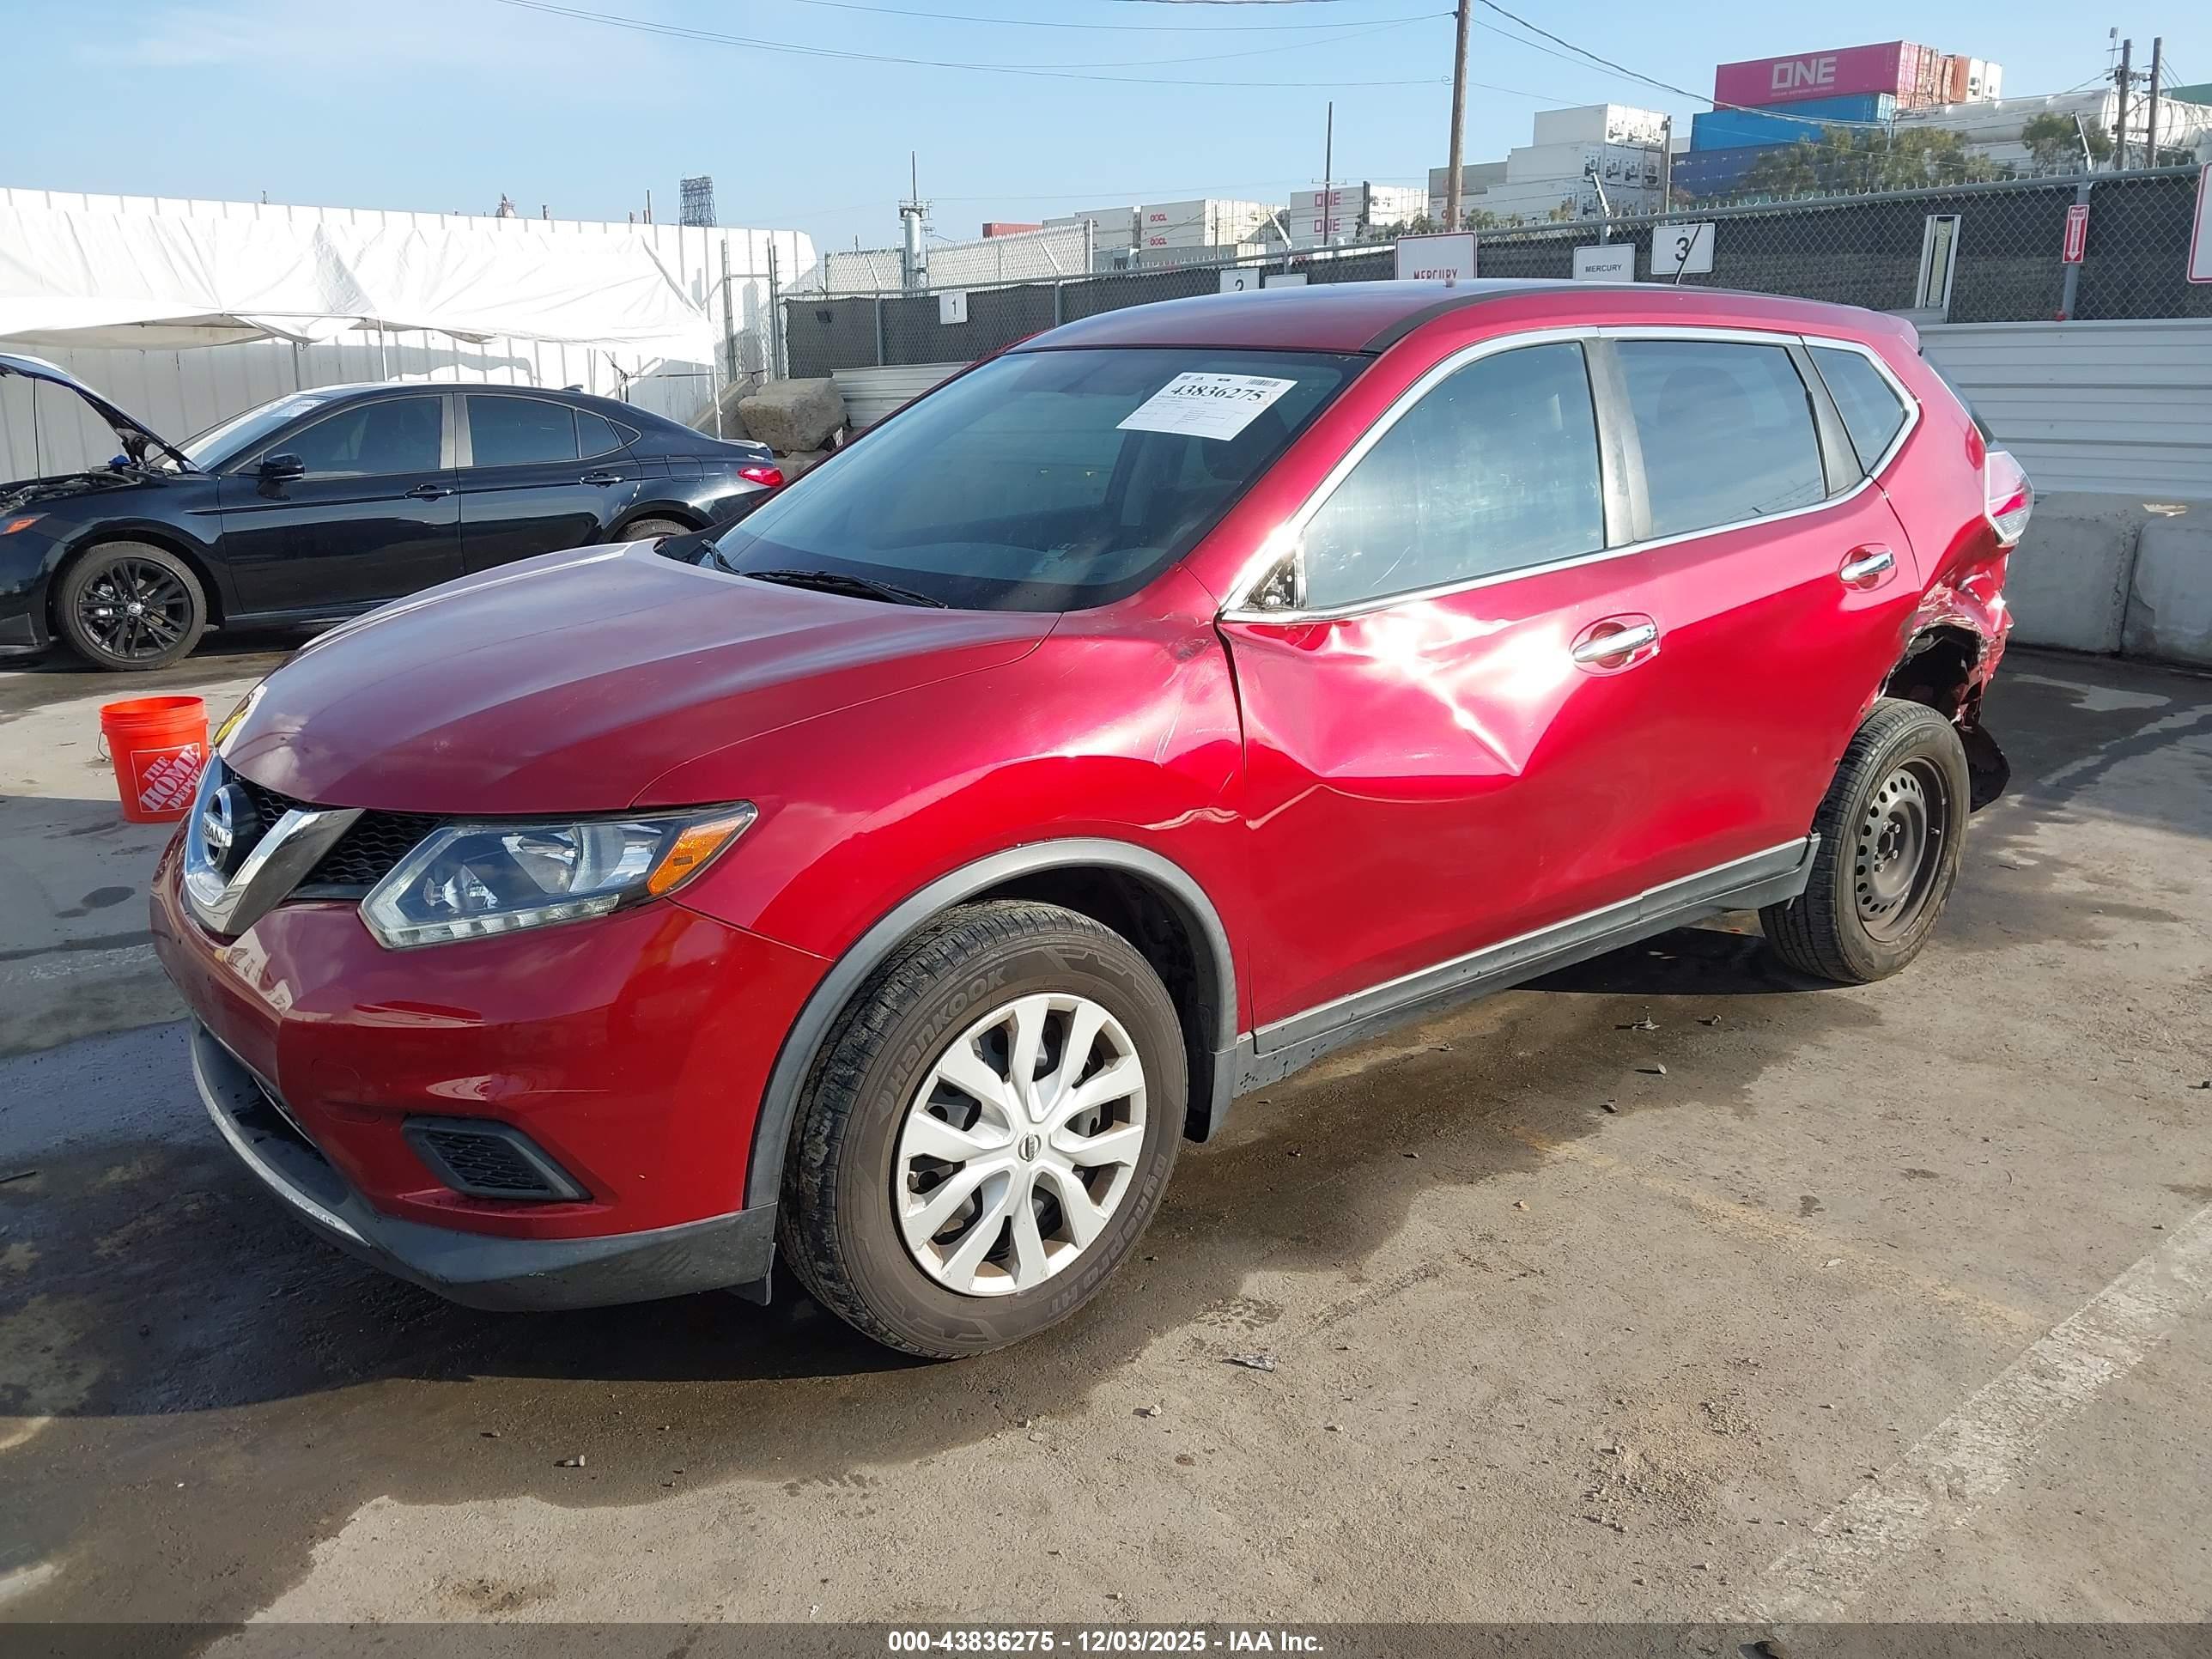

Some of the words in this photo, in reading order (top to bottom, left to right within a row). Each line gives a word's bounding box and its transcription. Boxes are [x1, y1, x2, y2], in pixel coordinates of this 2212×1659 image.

[1771, 56, 1836, 89] ONE
[1675, 237, 1690, 261] 3
[951, 299, 957, 315] 1
[1170, 385, 1267, 401] 43836275
[141, 745, 199, 811] HOME
[142, 756, 172, 781] THE
